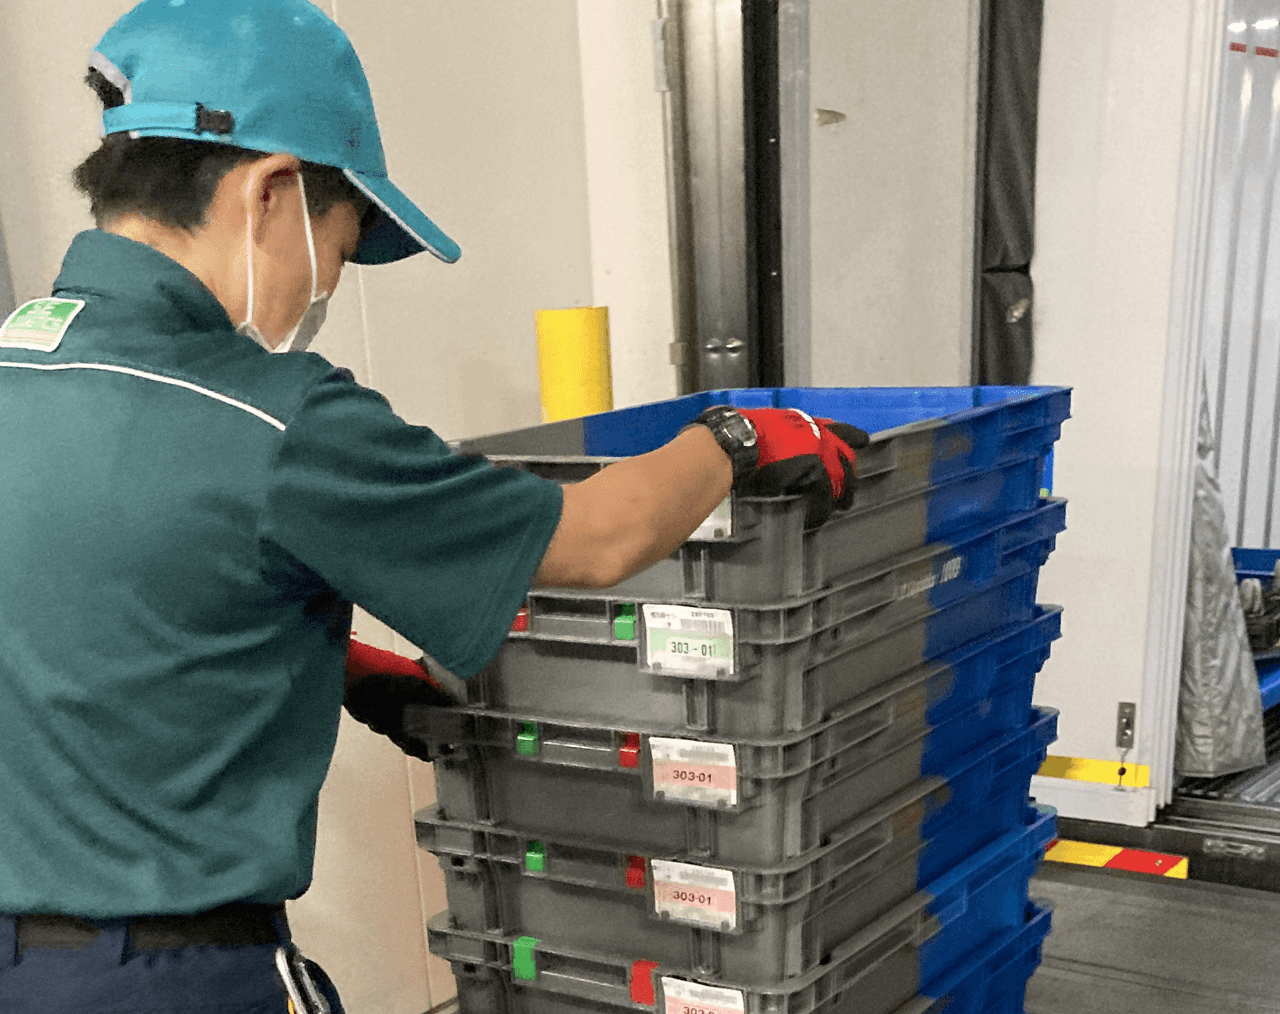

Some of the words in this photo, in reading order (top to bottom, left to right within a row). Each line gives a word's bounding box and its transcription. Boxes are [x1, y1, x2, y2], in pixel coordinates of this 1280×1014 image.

[671, 641, 689, 654] 303
[672, 770, 712, 783] 303-01
[673, 891, 711, 905] 303-01
